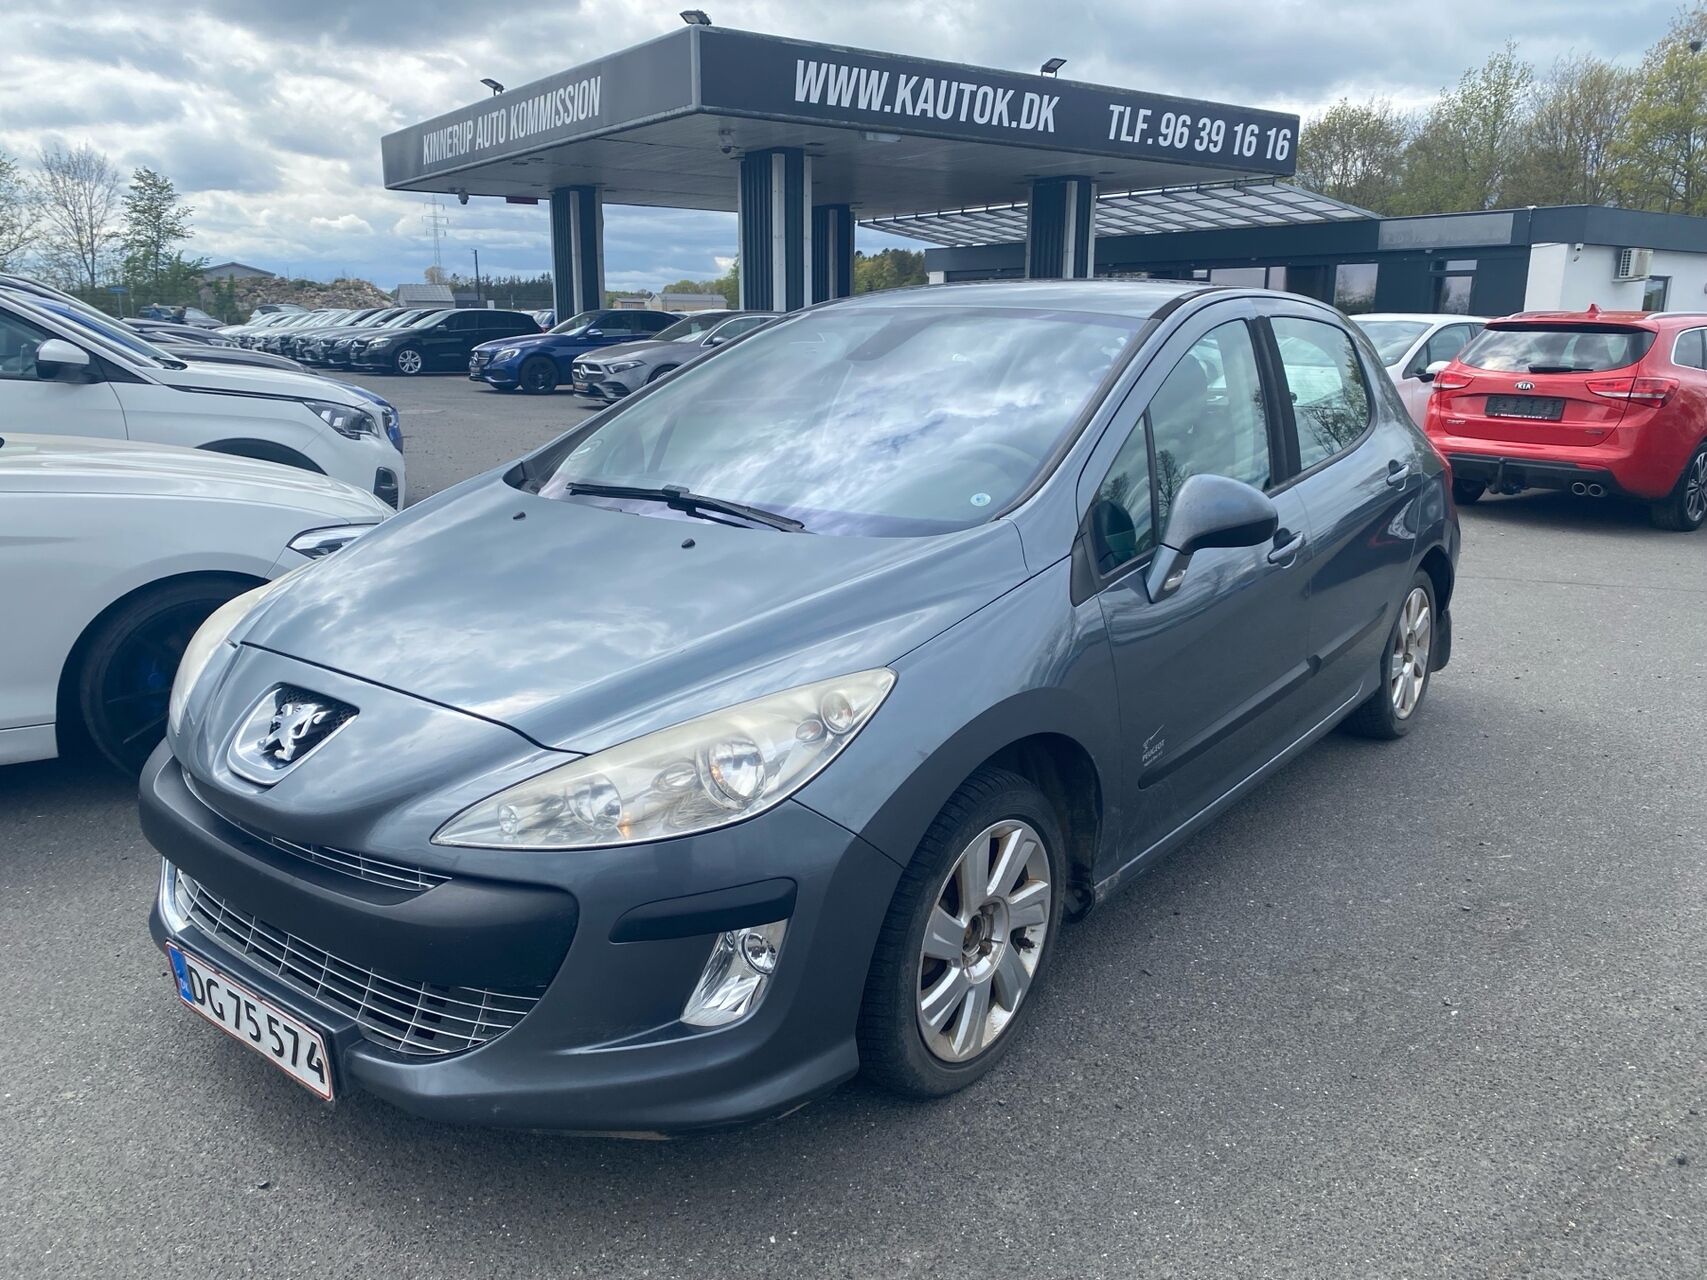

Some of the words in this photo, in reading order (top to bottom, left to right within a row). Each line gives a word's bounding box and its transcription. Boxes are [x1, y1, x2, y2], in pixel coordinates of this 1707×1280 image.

[423, 119, 474, 165] KINNERUP
[475, 108, 506, 150] AUTO
[509, 76, 601, 141] KOMMISSION
[794, 59, 1060, 133] WWW.KAUTOK.DK
[1108, 104, 1153, 145] TLF.
[1158, 112, 1191, 149] 96
[1194, 117, 1226, 153] 39
[1233, 123, 1259, 157] 16
[1265, 127, 1292, 161] 16
[266, 1013, 326, 1085] 574
